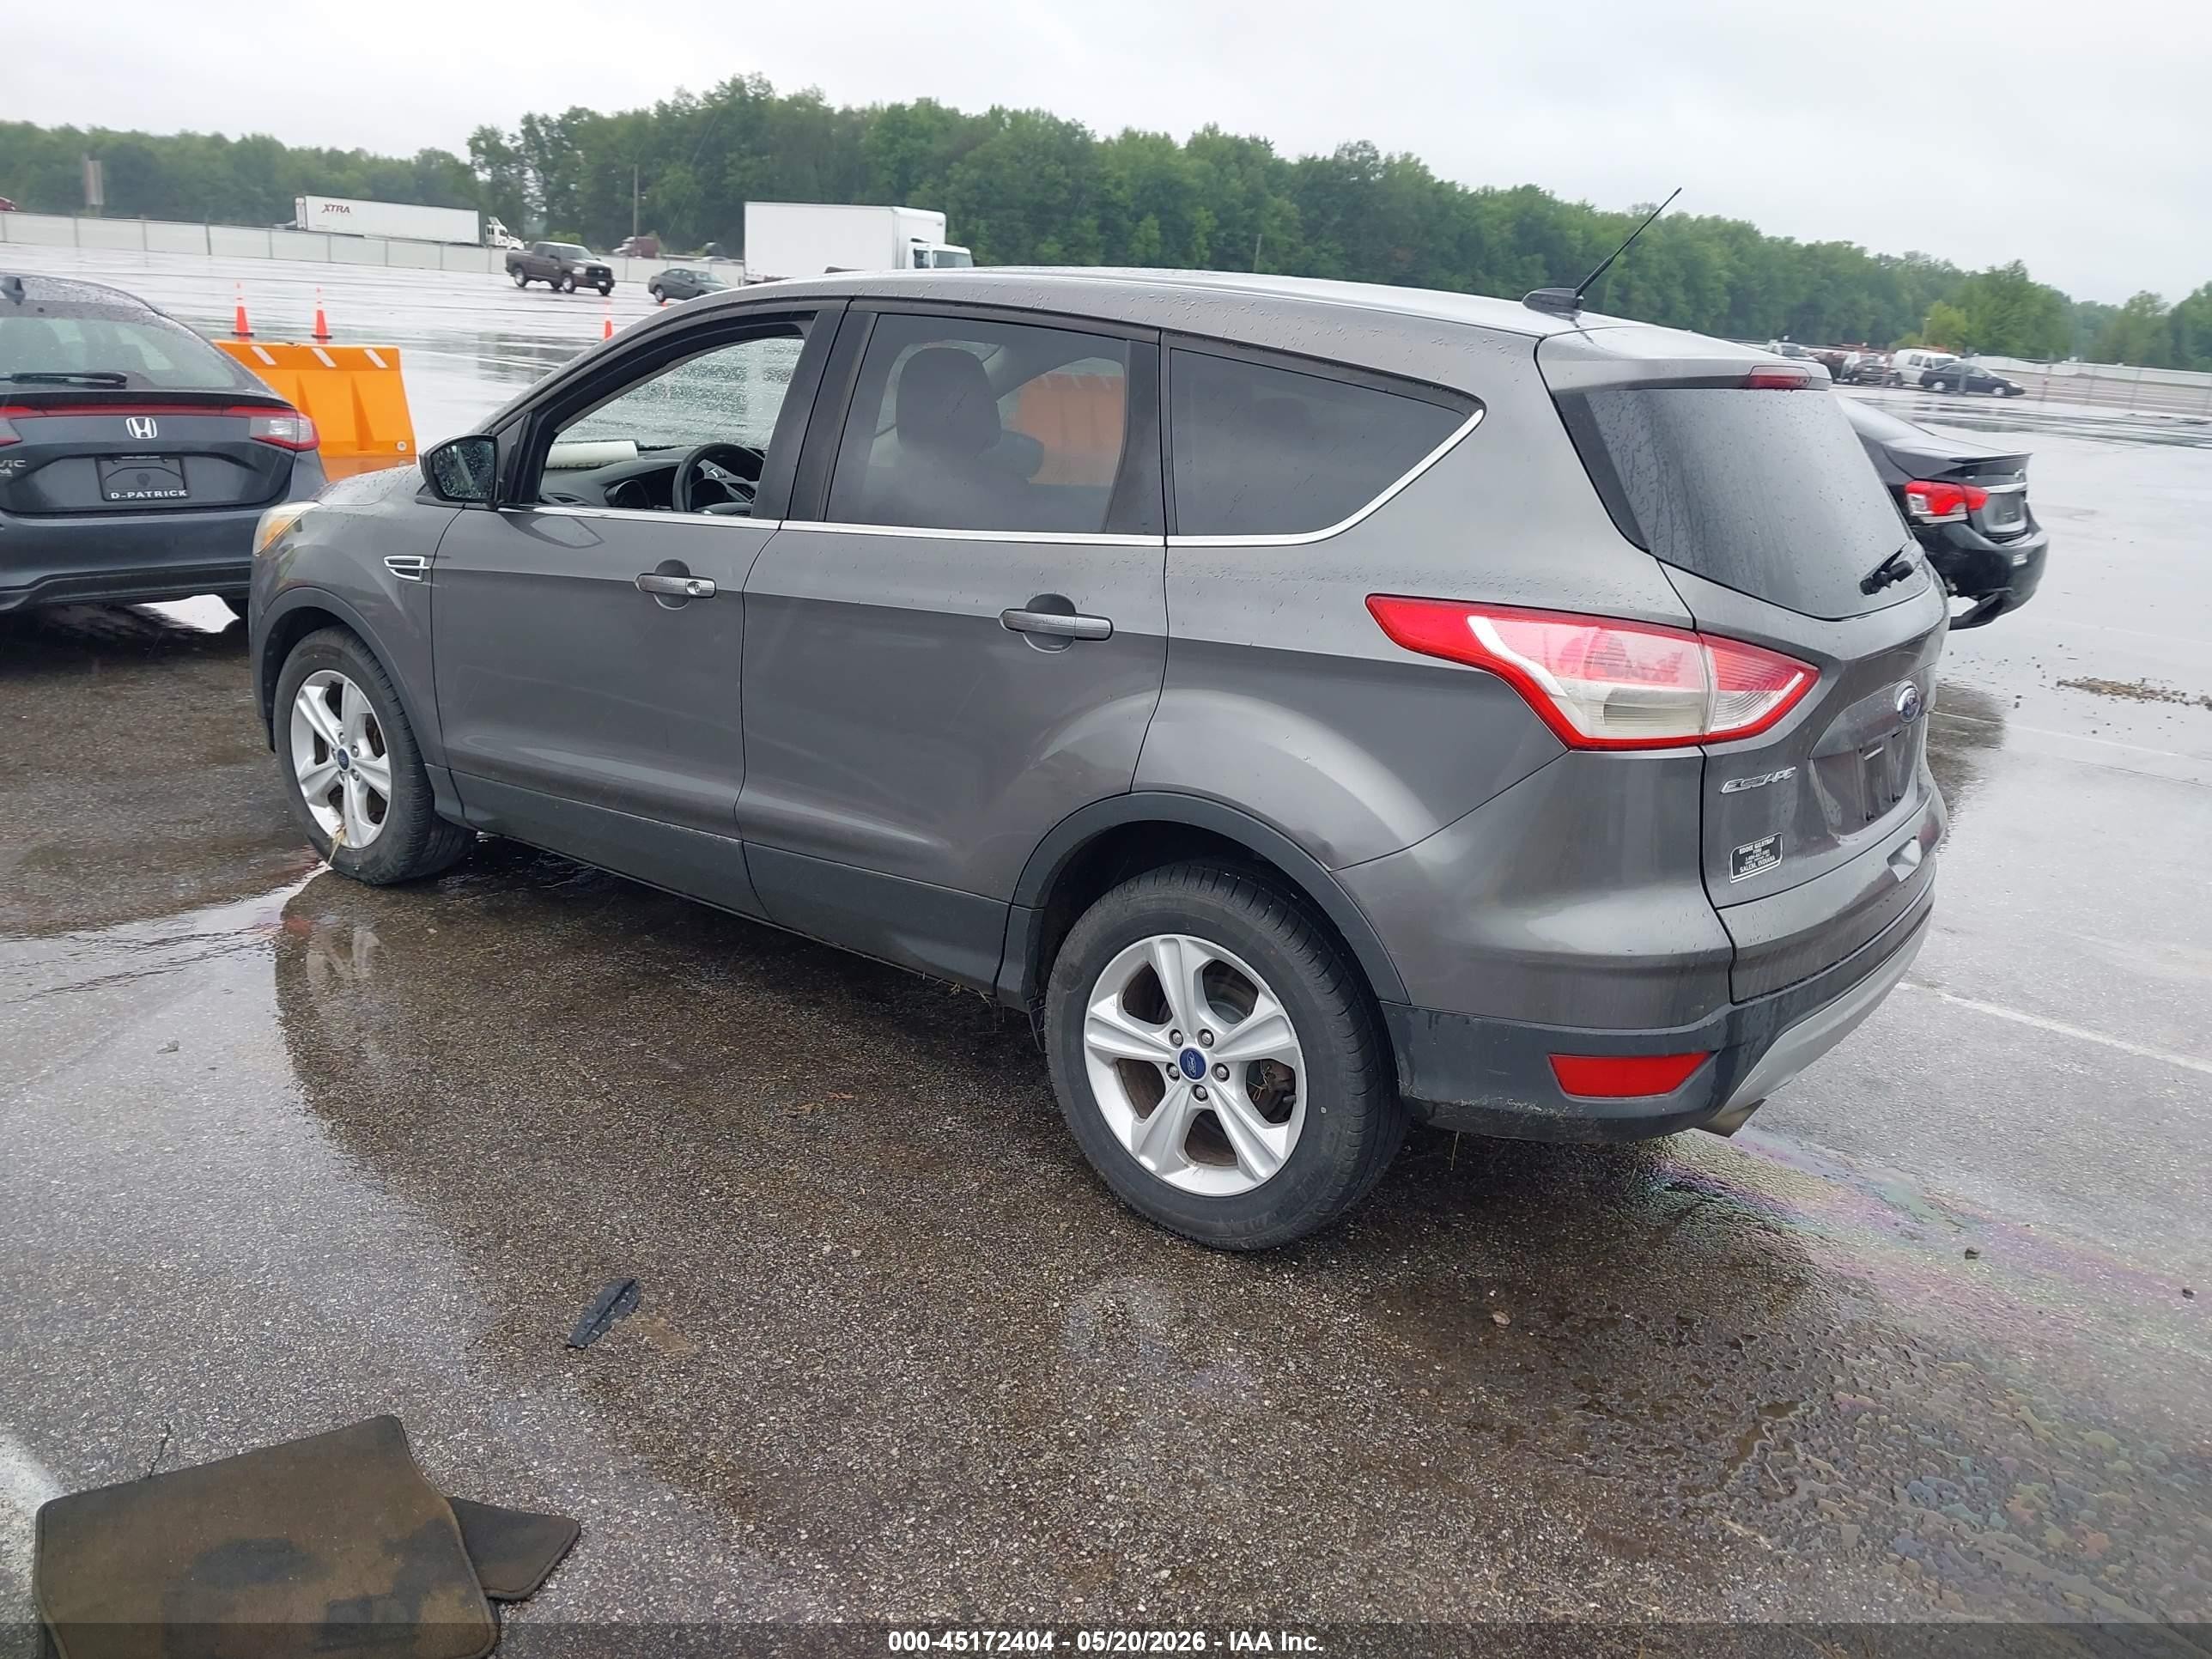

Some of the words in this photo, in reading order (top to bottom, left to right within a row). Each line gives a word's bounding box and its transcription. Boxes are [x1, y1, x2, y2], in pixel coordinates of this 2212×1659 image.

[321, 204, 350, 214] XTRA
[110, 490, 187, 499] D-PATRICK
[1721, 767, 1796, 793] ESCAPE
